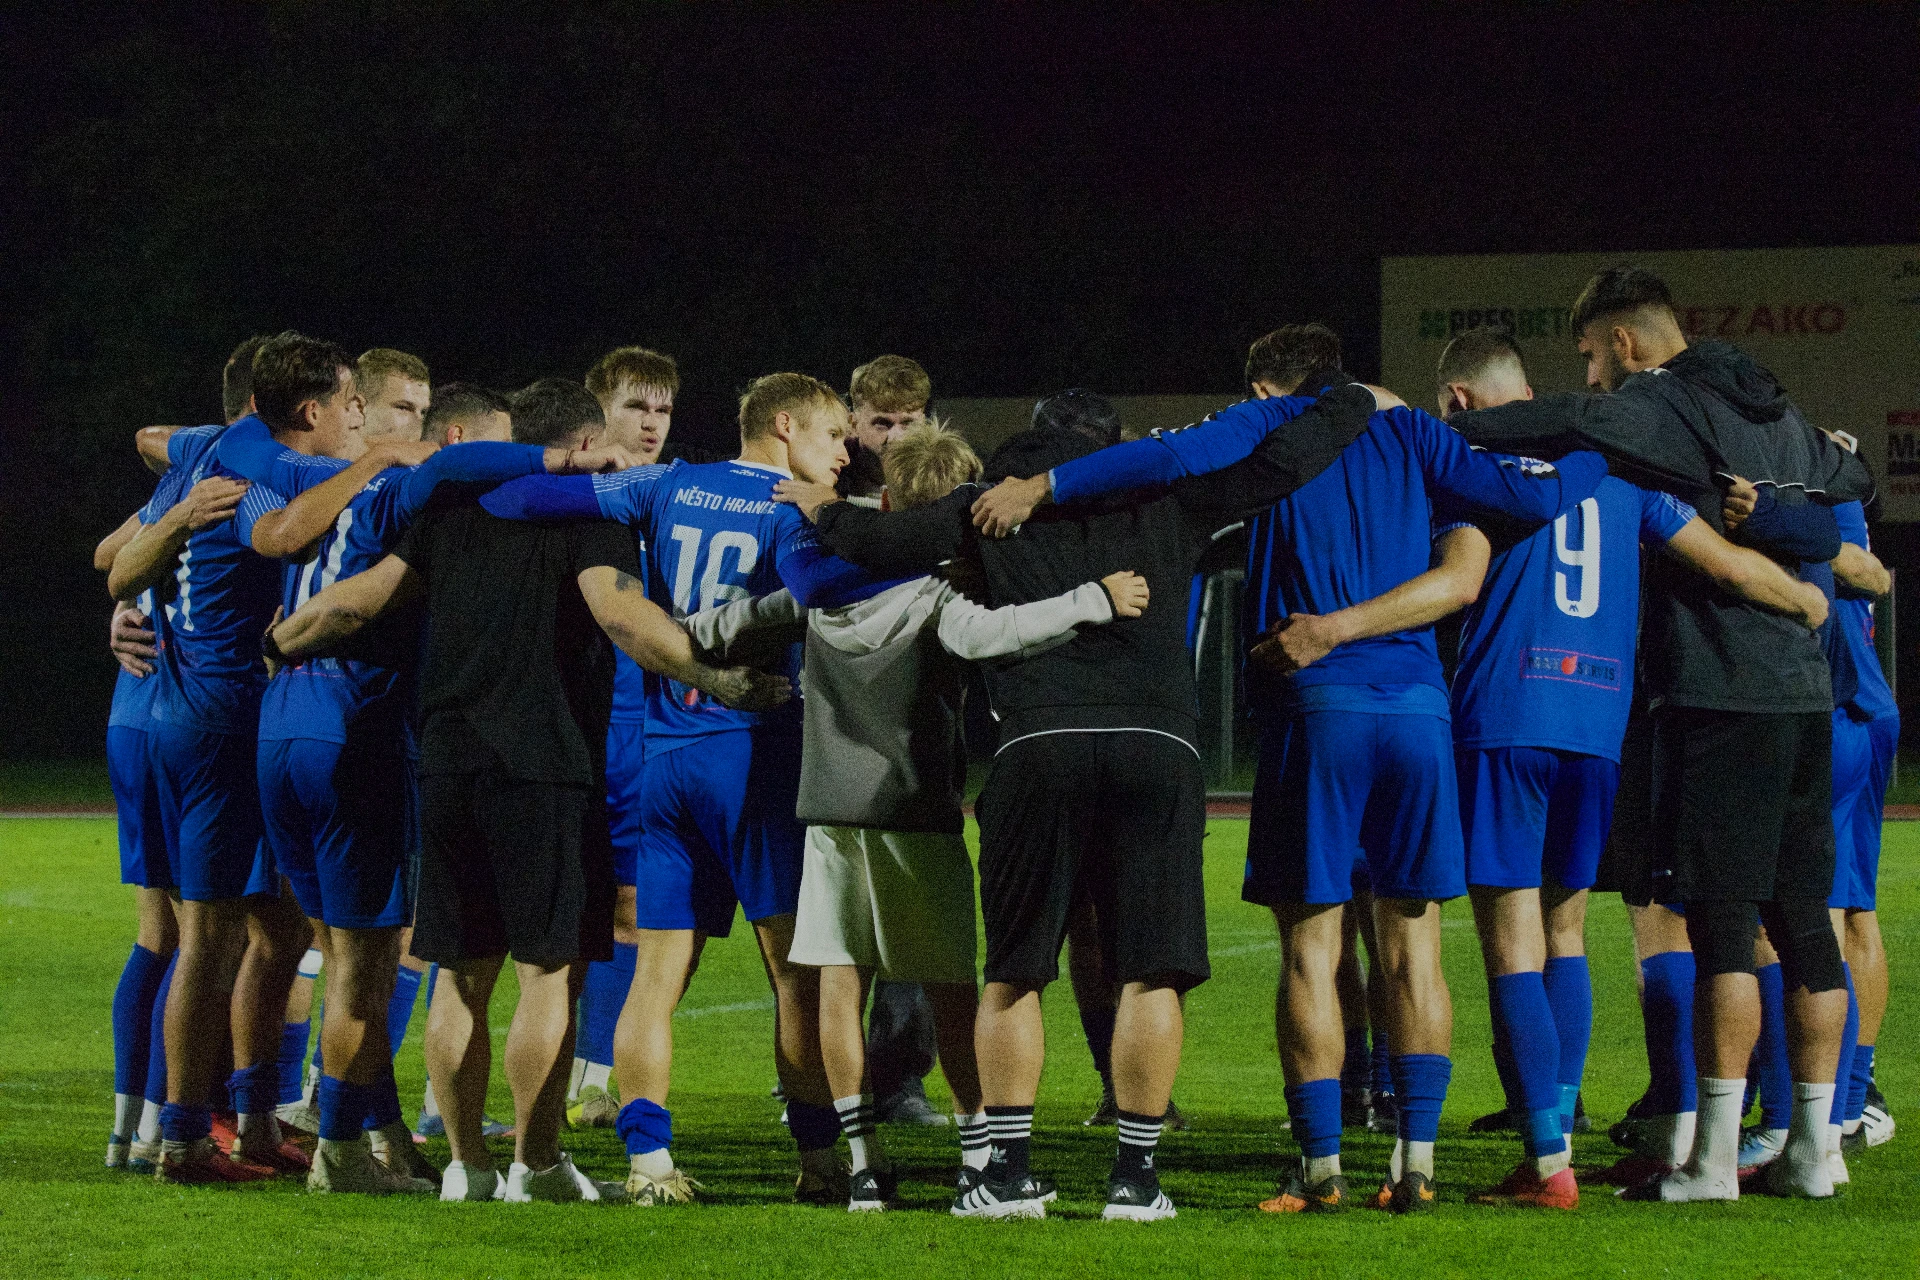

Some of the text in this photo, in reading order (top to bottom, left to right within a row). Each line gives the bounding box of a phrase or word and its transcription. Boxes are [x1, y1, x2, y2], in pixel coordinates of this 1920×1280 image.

[1672, 305, 1845, 335] EZAKO
[674, 486, 724, 511] MĚSTO
[671, 524, 759, 618] 16
[1555, 497, 1601, 619] 9
